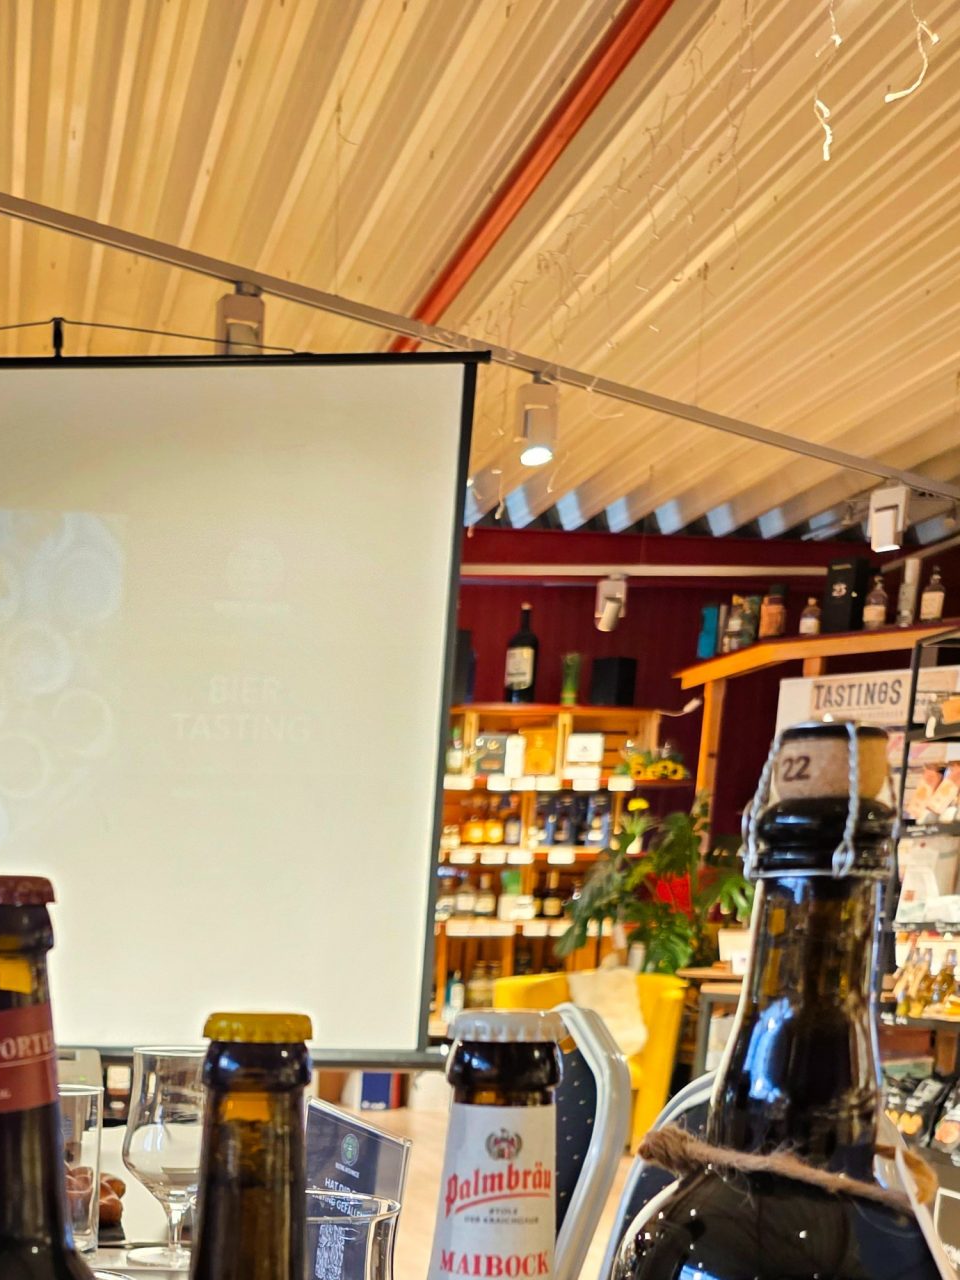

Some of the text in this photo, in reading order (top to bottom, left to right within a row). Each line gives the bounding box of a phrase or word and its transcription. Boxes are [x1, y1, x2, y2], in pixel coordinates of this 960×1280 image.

[208, 673, 283, 705] BIER
[814, 679, 903, 711] TASTINGS
[170, 712, 312, 743] TASTING
[445, 1162, 551, 1218] Palmbräu
[440, 1249, 550, 1278] MAIBOCK
